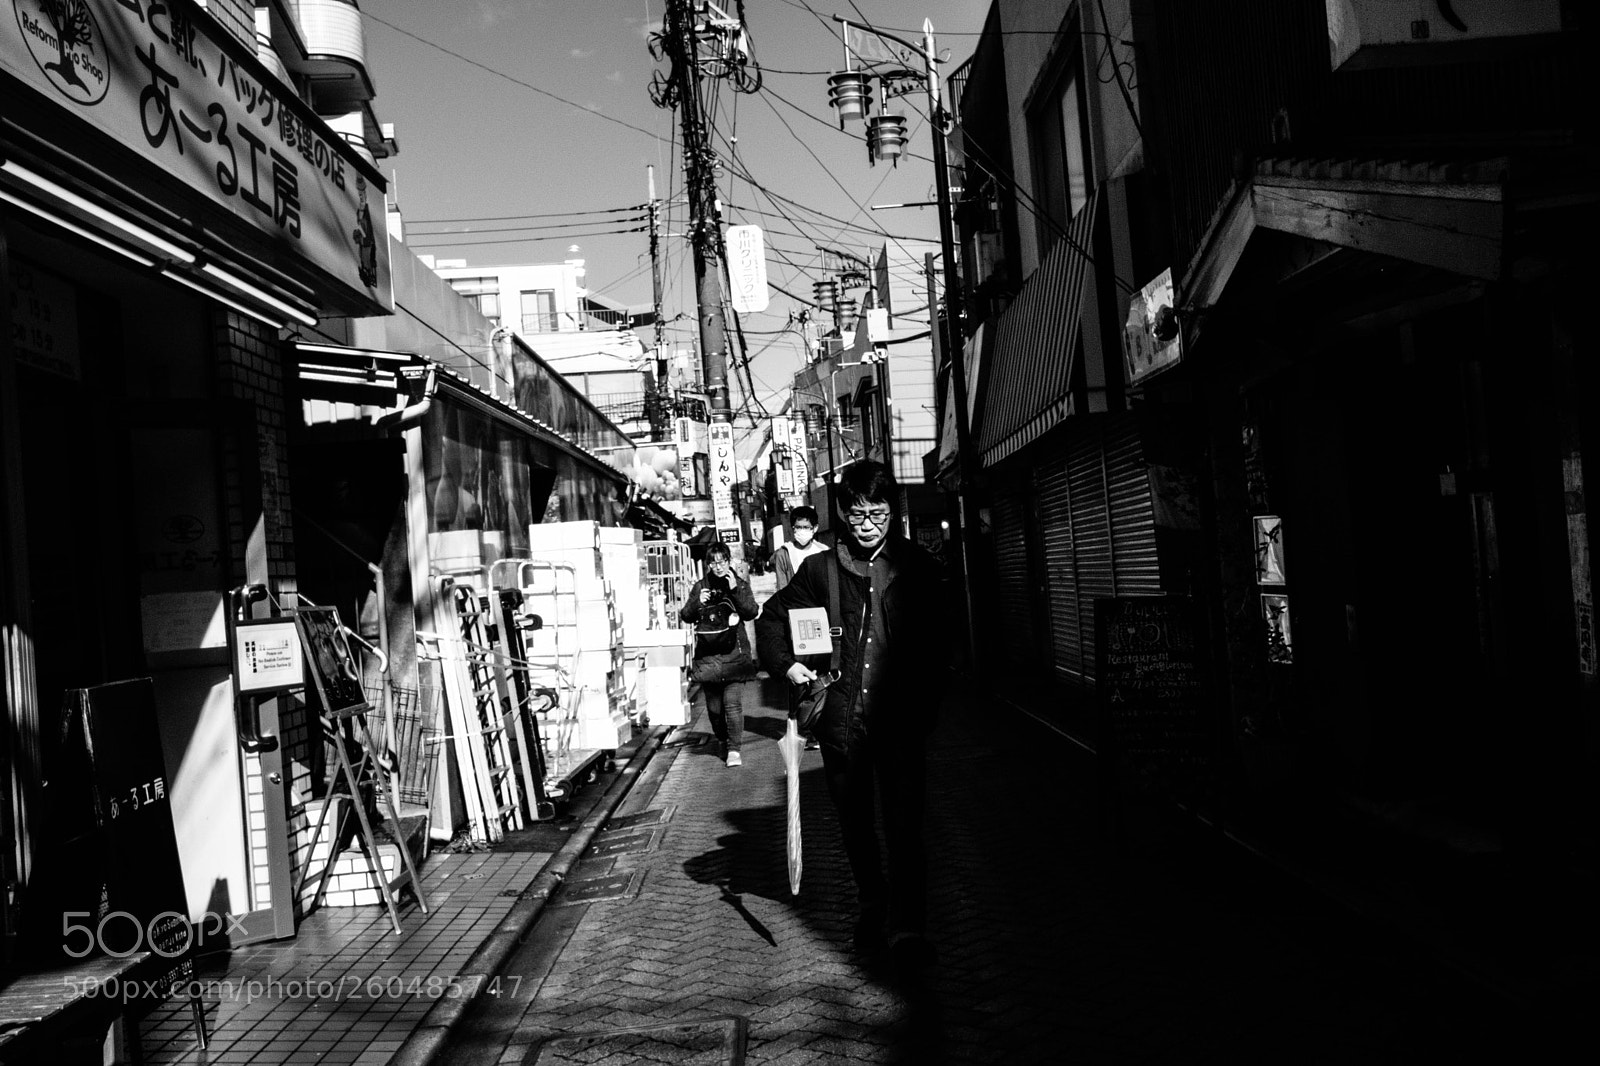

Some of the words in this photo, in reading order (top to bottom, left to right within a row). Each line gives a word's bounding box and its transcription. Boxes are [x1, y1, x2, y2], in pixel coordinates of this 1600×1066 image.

[22, 11, 59, 51] Reform
[64, 40, 80, 65] Pro
[81, 53, 104, 85] Shop
[116, 0, 347, 193] と靴、バッグ修理の店
[136, 42, 302, 239] あーる工房
[717, 446, 731, 487] しんや
[108, 776, 166, 820] あーる工房
